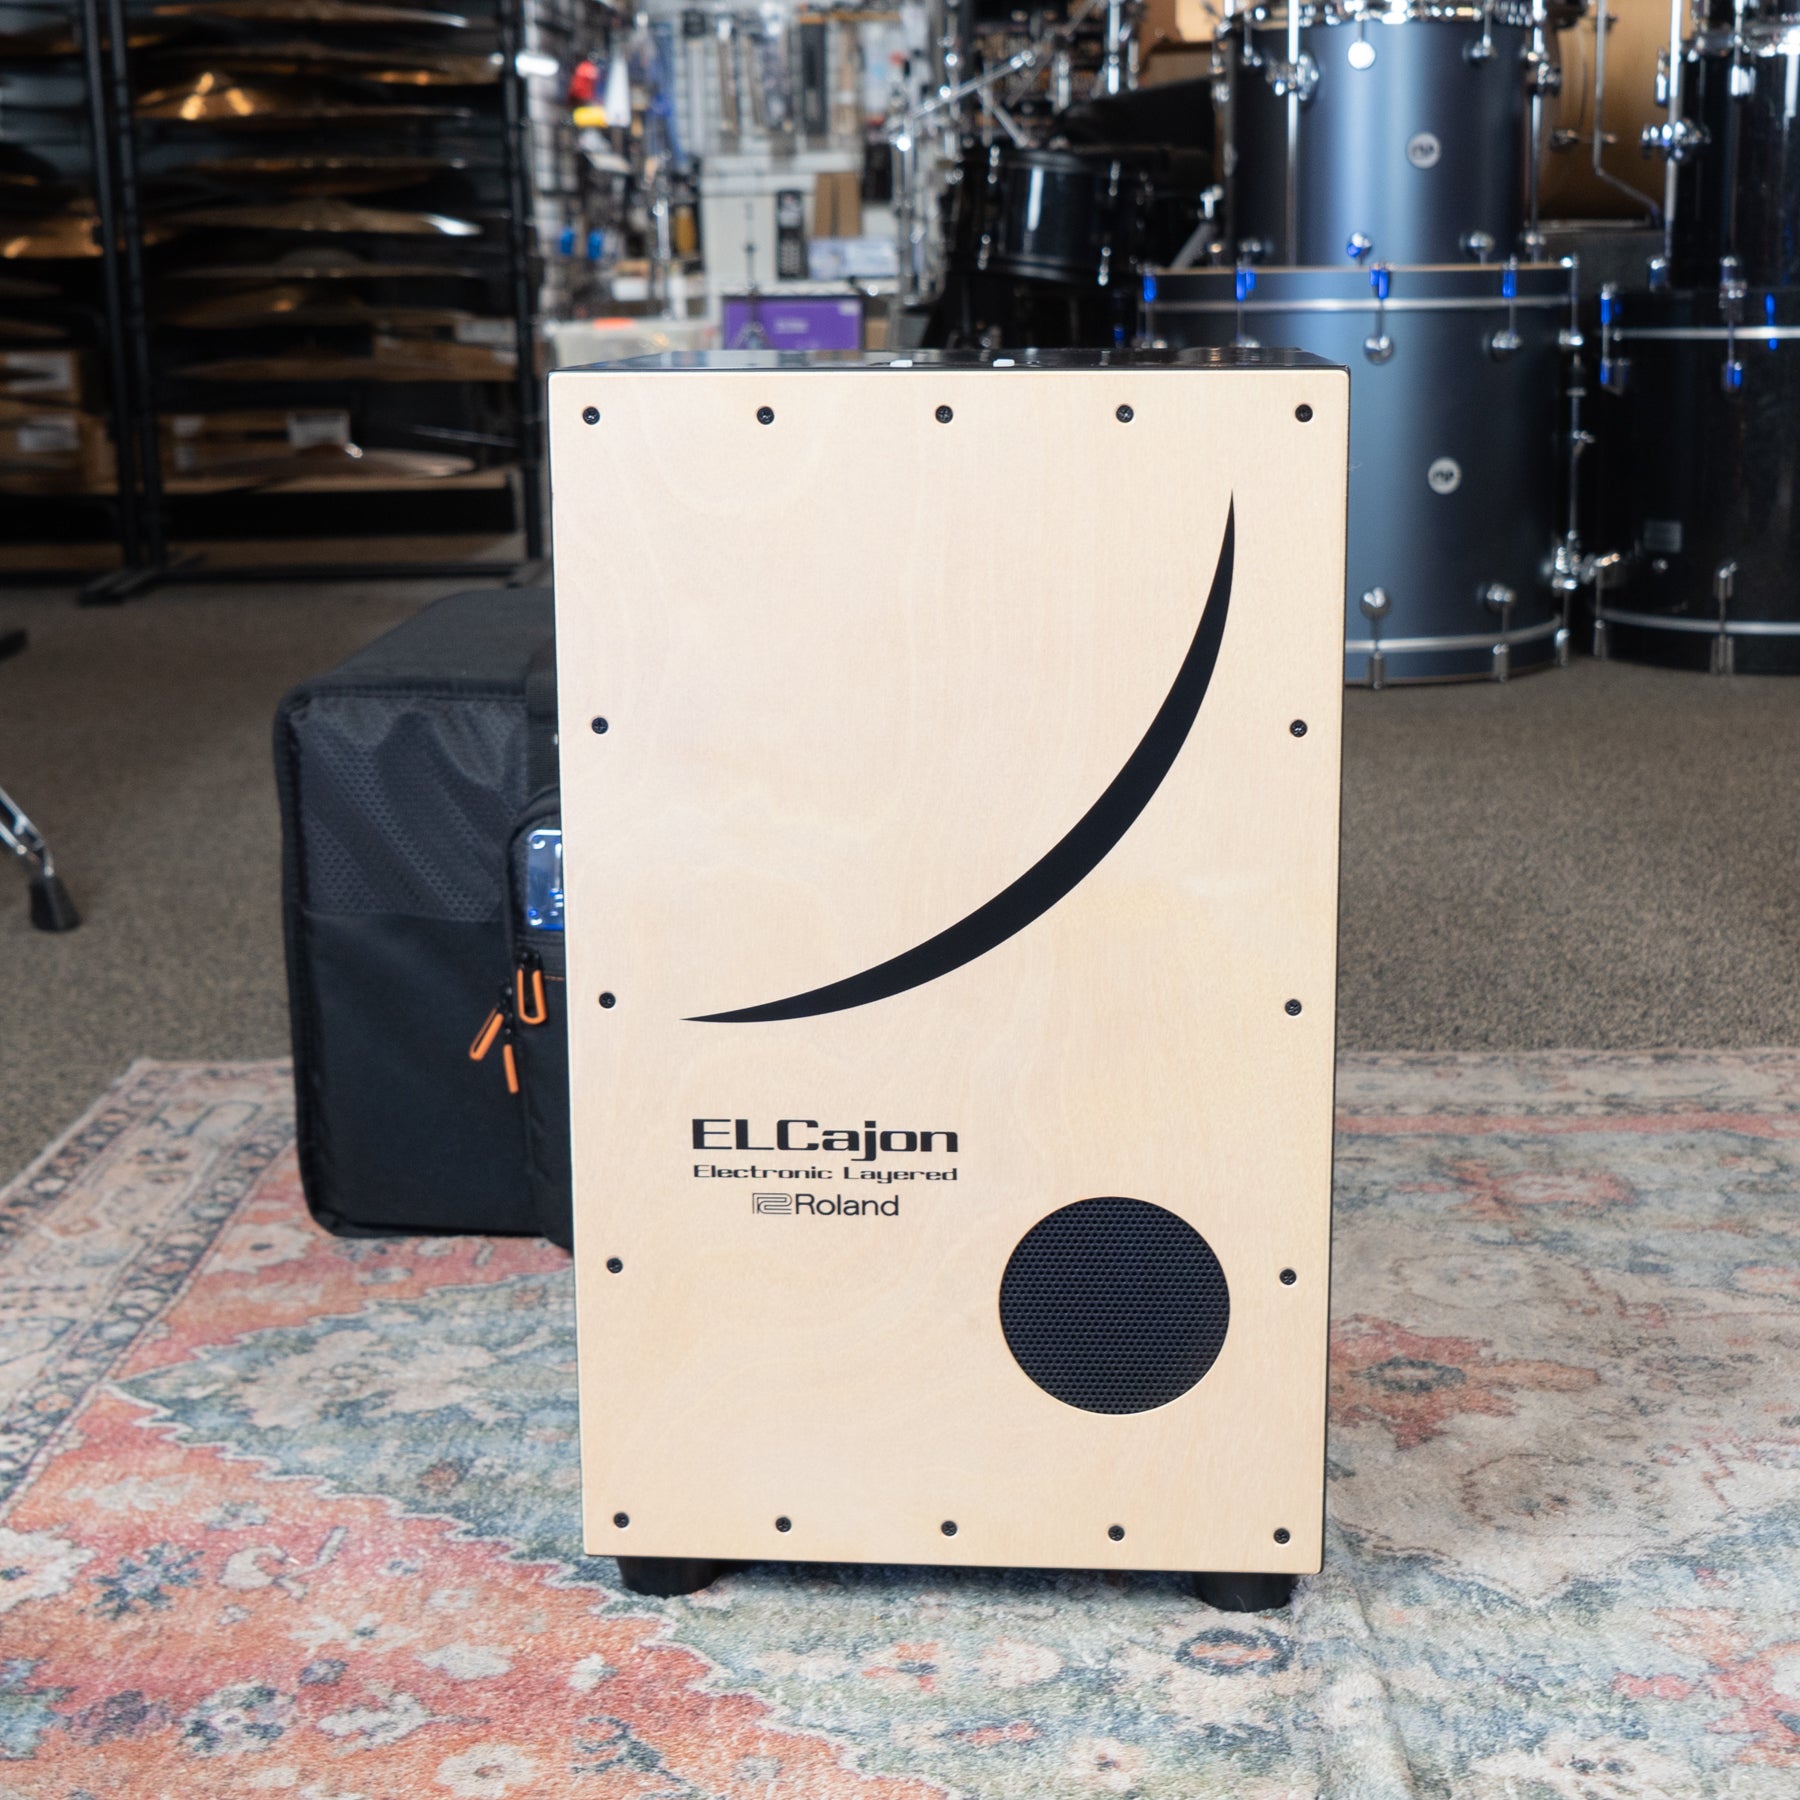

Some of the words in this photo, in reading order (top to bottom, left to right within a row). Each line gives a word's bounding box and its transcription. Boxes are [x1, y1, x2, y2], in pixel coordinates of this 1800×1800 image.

[693, 1164, 833, 1180] Electronic
[843, 1166, 958, 1184] Layered
[795, 1193, 899, 1217] Roland
